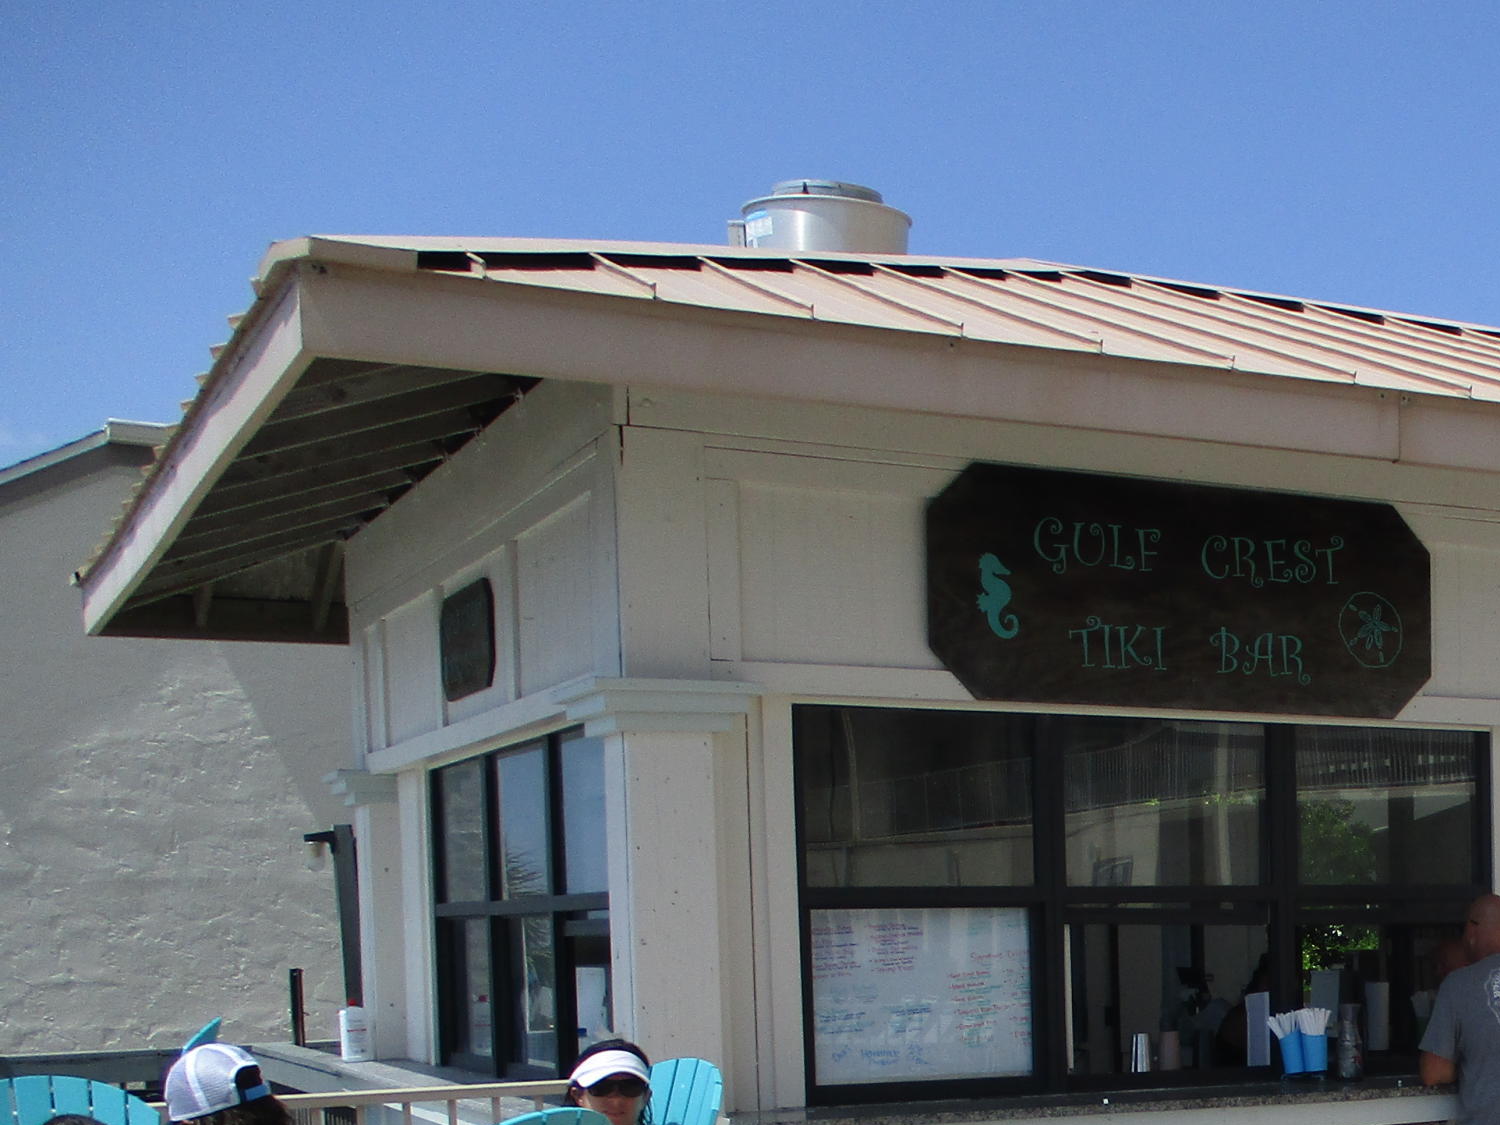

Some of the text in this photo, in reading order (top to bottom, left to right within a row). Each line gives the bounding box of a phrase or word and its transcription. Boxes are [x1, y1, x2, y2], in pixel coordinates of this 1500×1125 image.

[1033, 517, 1344, 587] GULF CREST
[1069, 616, 1311, 684] TIKI BAR
